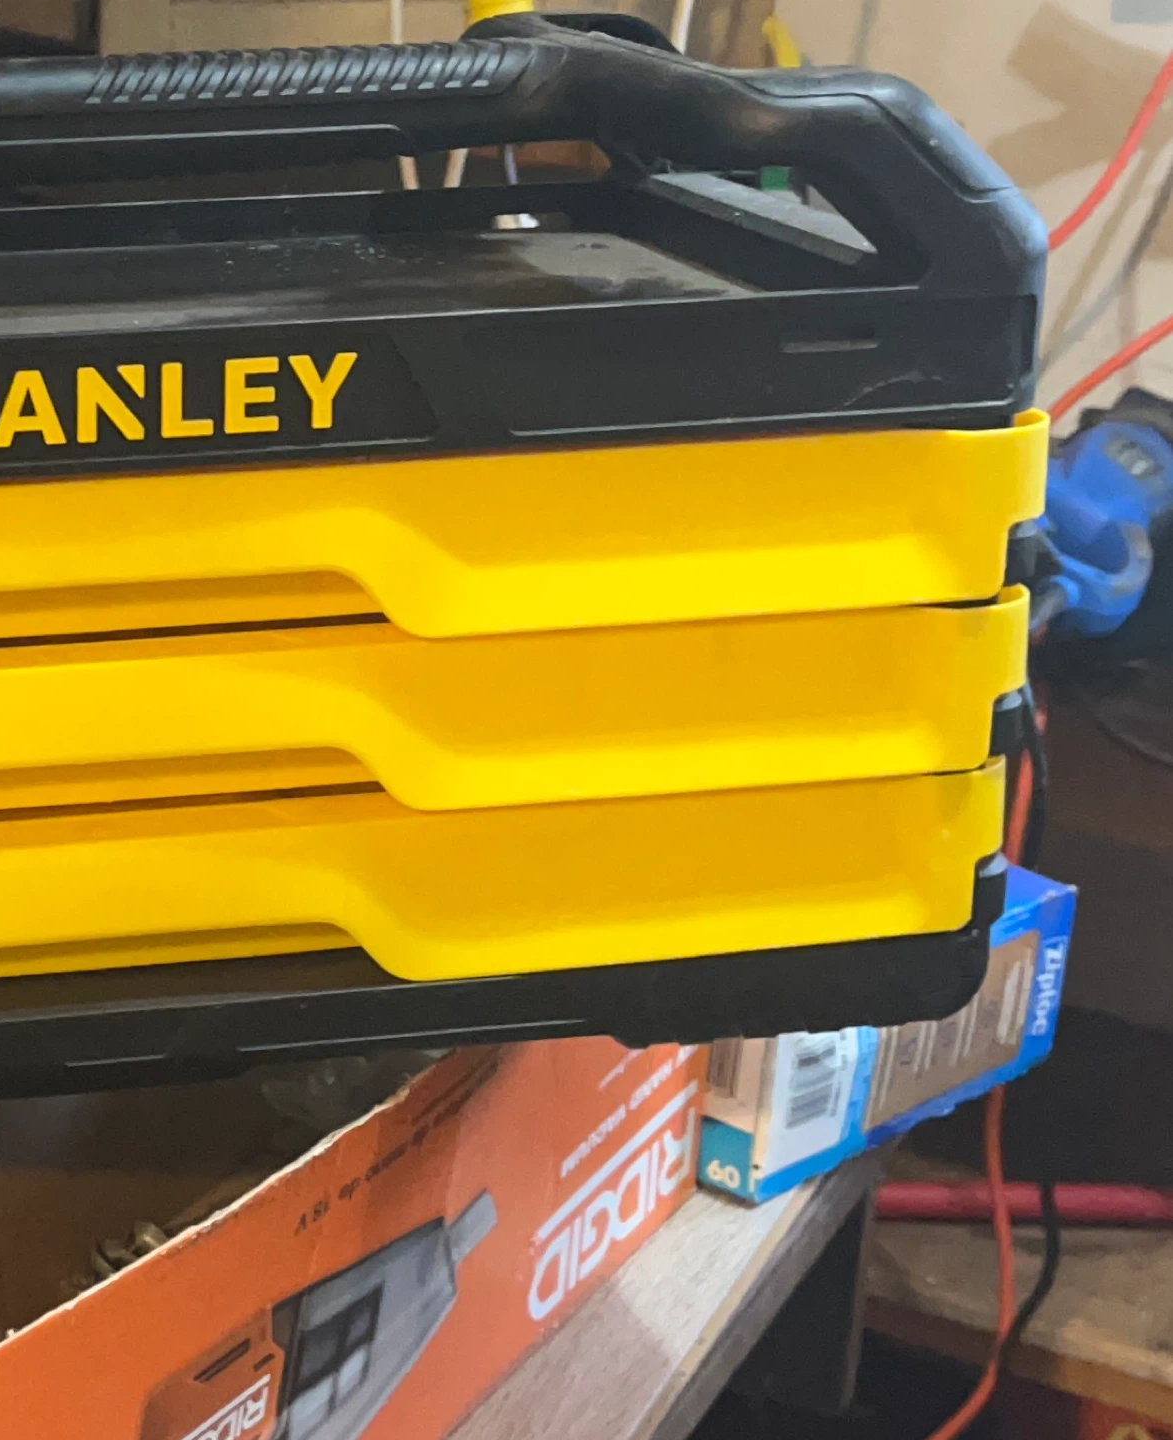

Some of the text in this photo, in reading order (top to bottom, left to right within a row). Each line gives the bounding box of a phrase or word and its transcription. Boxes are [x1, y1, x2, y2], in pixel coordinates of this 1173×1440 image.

[1034, 942, 1065, 1035] Ziploc
[527, 1106, 696, 1321] RIDGID
[706, 1157, 741, 1191] 60
